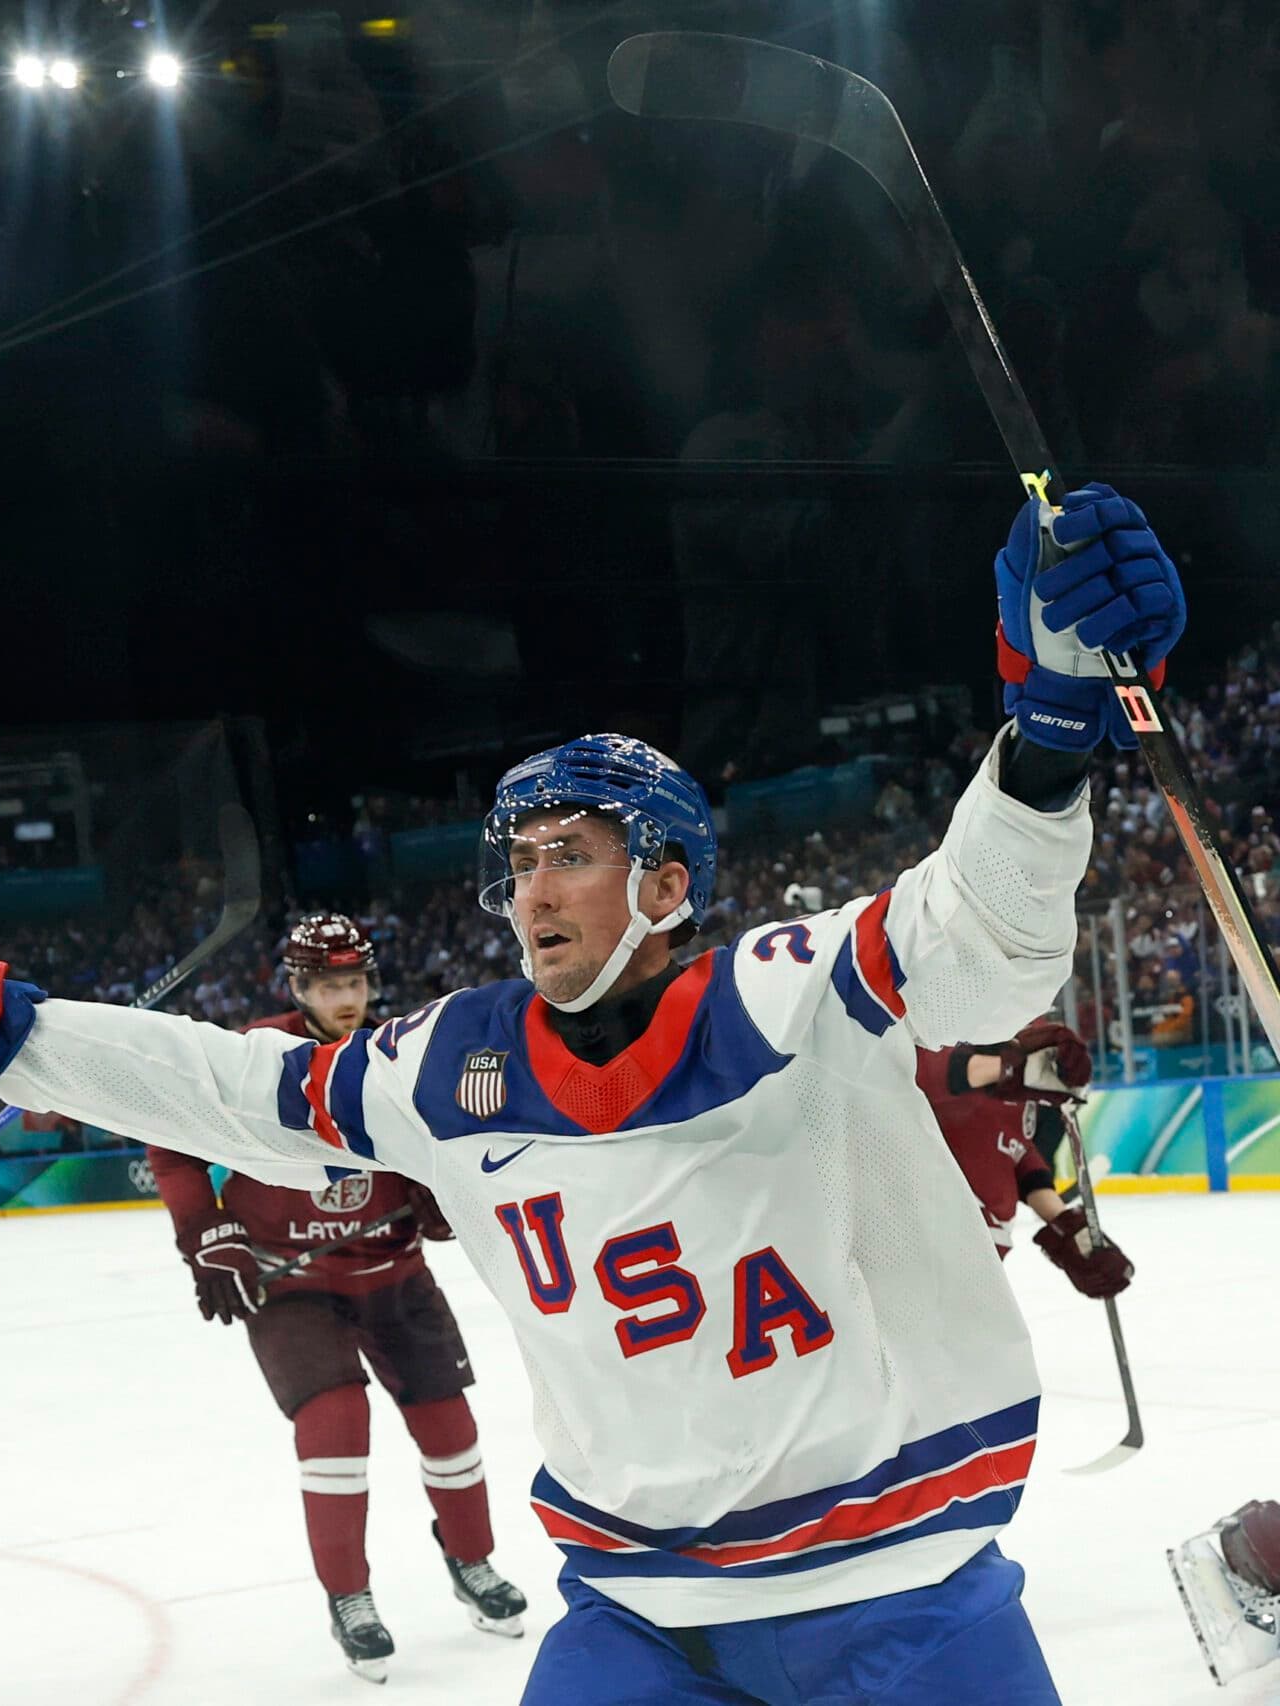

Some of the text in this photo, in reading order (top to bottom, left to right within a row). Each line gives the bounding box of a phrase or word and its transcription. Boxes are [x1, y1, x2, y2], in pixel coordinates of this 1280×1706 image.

[1030, 710, 1086, 732] BAUER
[469, 1055, 498, 1071] USA
[495, 1191, 834, 1378] USA
